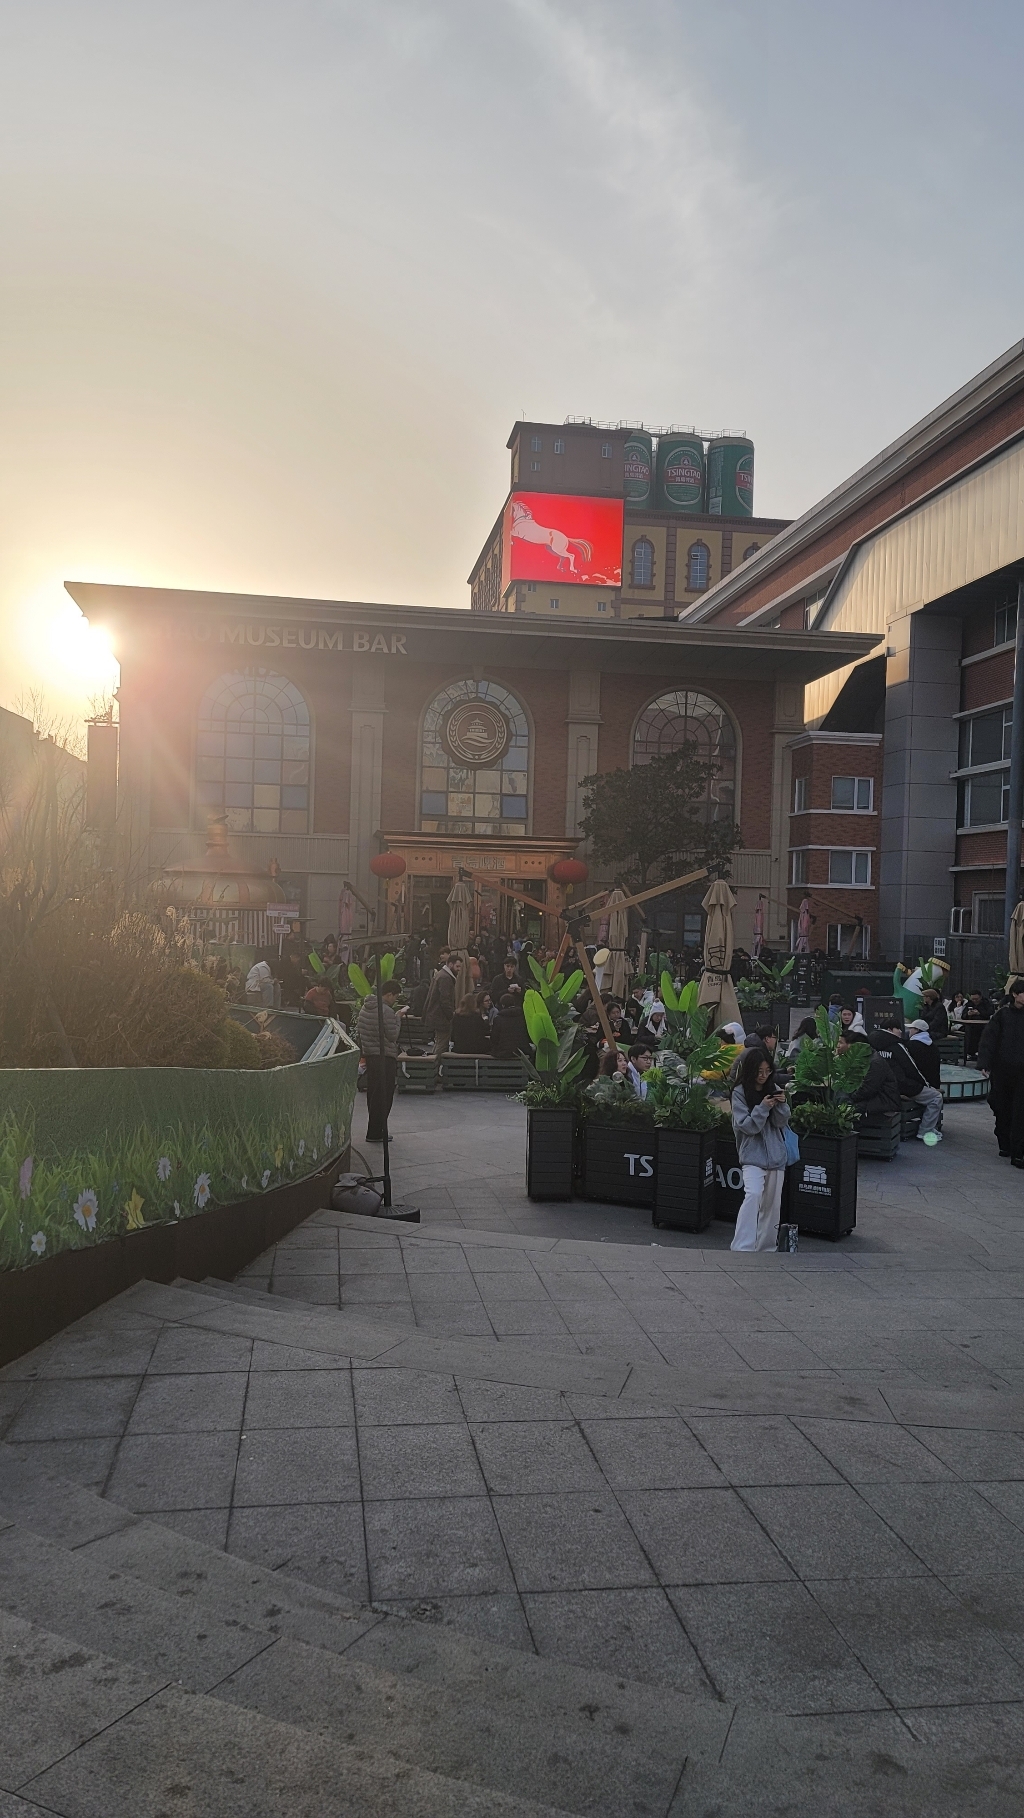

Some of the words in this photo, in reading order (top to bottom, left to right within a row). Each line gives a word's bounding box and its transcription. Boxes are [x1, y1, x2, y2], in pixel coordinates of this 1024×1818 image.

[667, 469, 701, 479] TSINGTAO
[219, 624, 343, 650] MUSEUM
[353, 631, 408, 655] BAR
